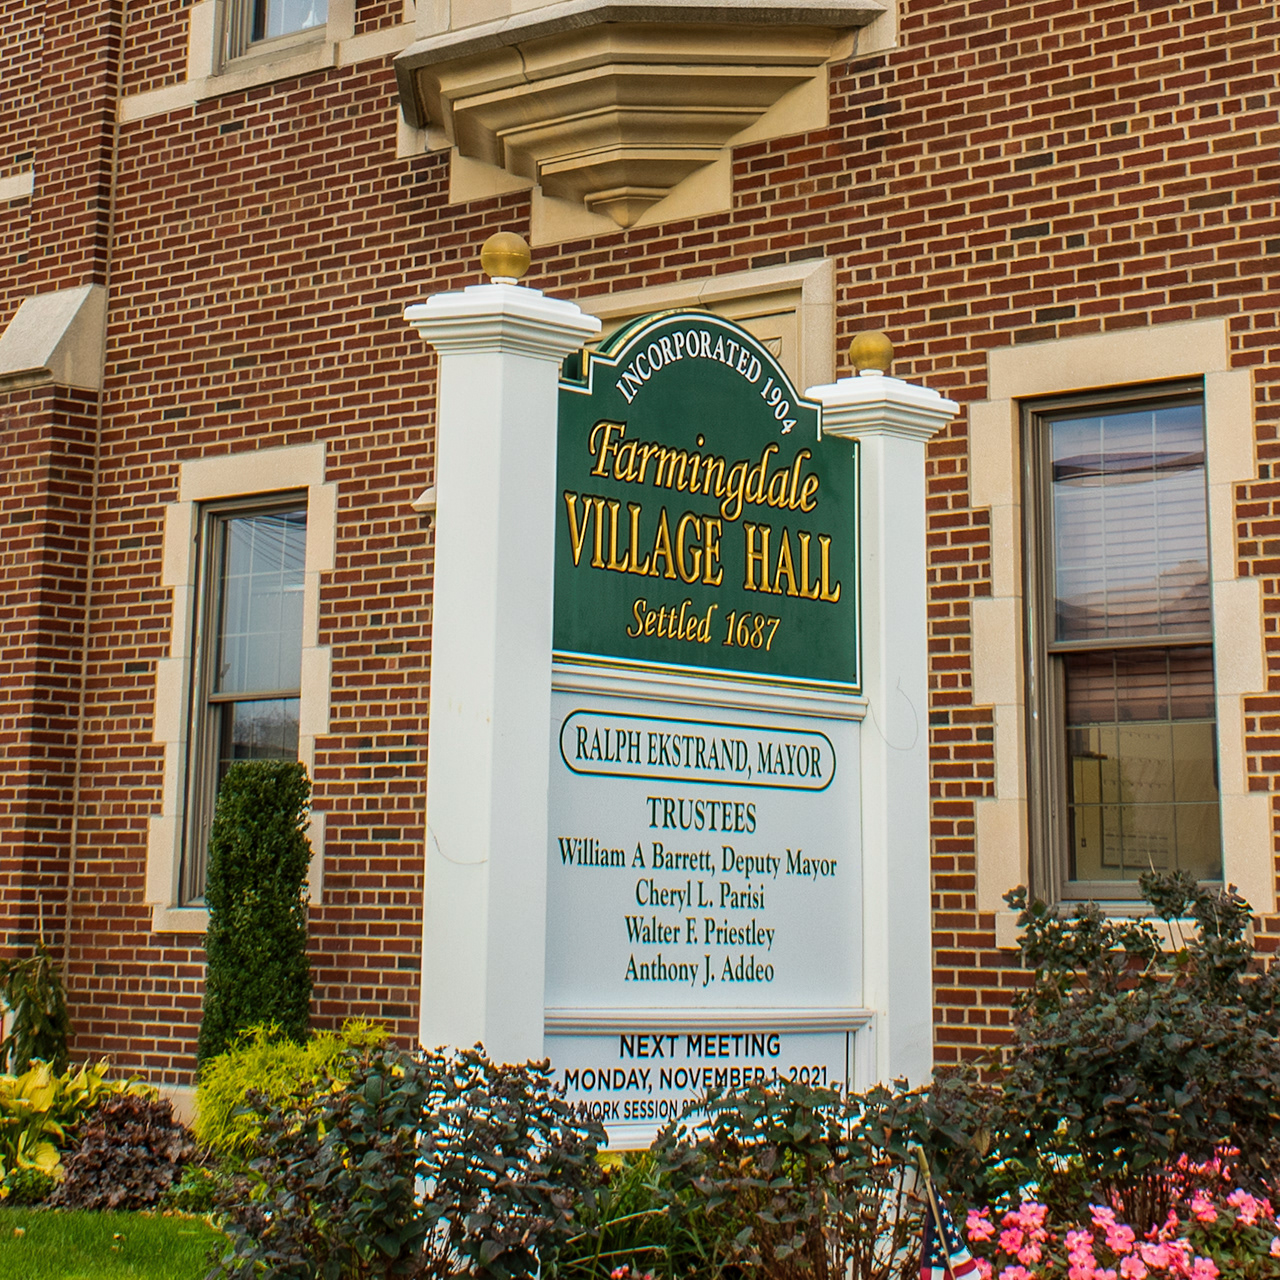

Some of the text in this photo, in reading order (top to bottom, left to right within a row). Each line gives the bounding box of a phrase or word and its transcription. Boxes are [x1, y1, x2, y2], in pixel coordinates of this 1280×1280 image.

[616, 329, 798, 435] INCORPORATED 1904
[588, 419, 820, 521] Farmingdale
[563, 490, 842, 604] VILLAGE HALL
[627, 597, 782, 652] Settled 1687
[575, 725, 823, 779] RALPH EKSTRAND, MAYOR
[646, 795, 757, 834] TRUSTEES
[558, 837, 838, 881] William A Barrett, Deputy Mayor
[635, 878, 765, 913] Cheryl L. Parisi
[624, 915, 776, 951] Walter F. Priestley
[624, 953, 775, 987] Anthony J. Addeo
[620, 1033, 781, 1058] NEXT MEETING
[564, 1067, 653, 1094] MONDAY,
[789, 1065, 827, 1087] 2021
[623, 1099, 678, 1119] SESSION
